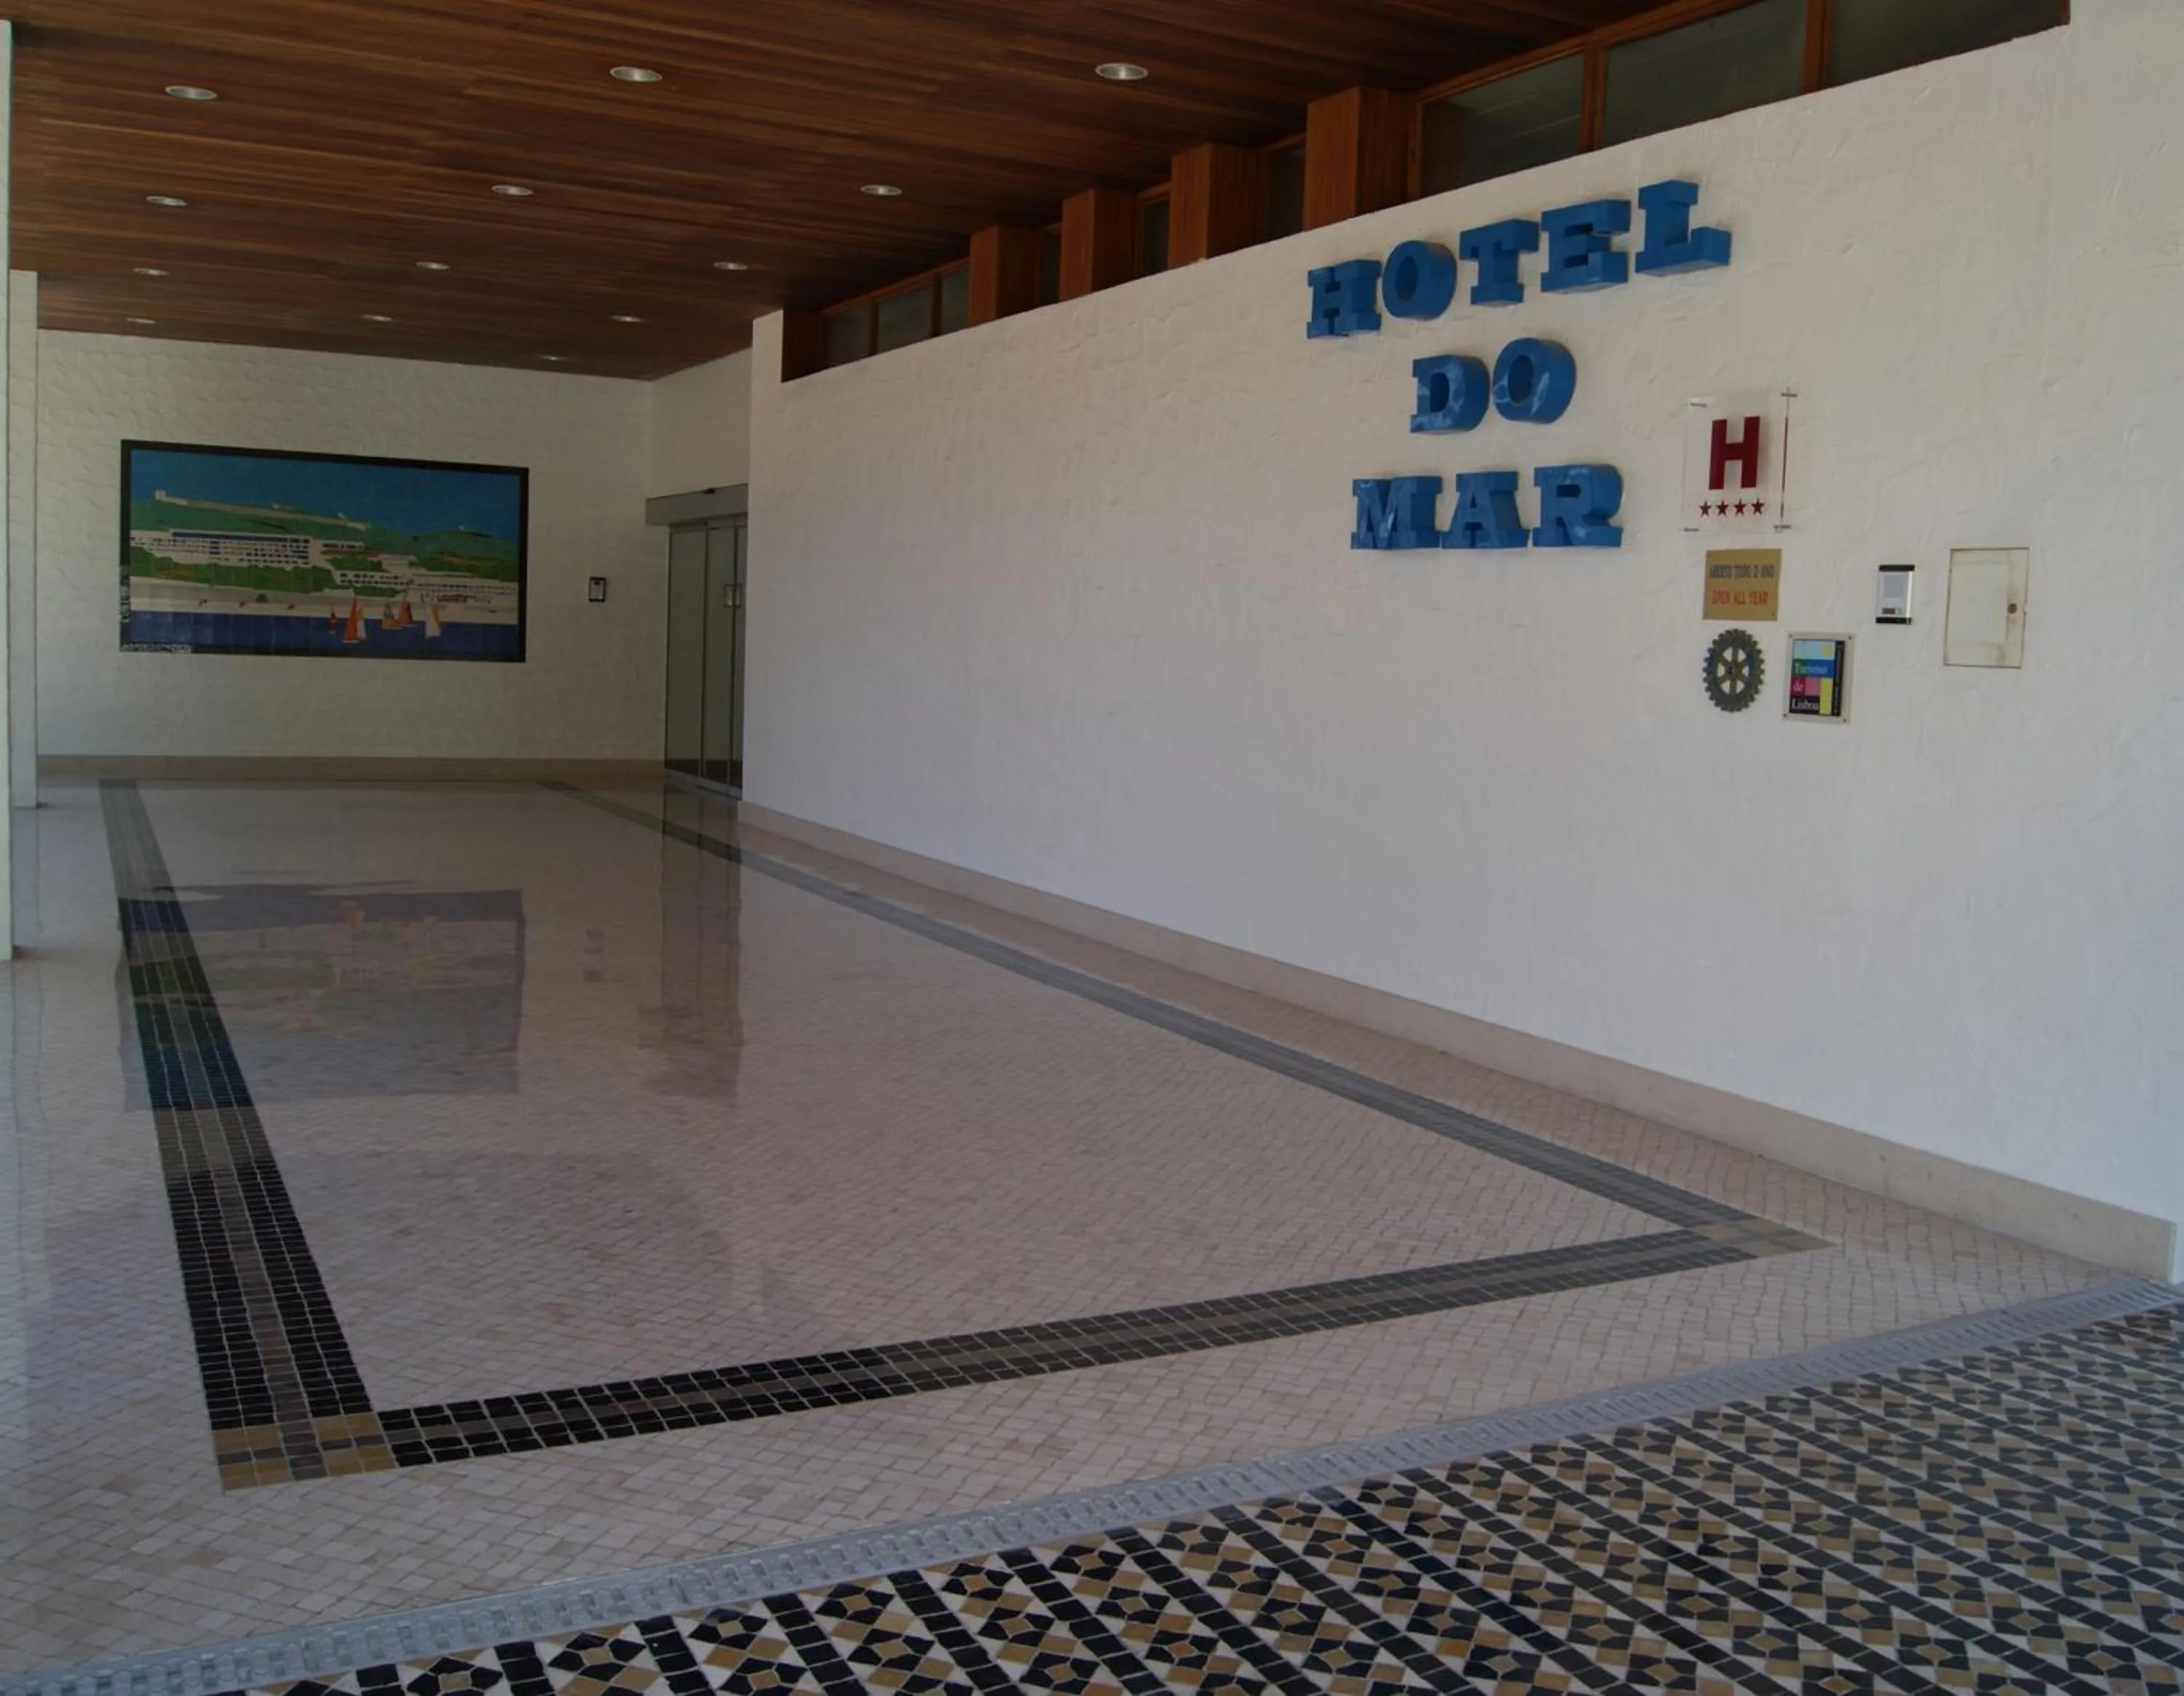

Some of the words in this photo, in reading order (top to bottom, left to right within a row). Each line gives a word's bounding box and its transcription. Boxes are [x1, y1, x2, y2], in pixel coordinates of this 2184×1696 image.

[1307, 180, 1731, 339] HOTEL
[1409, 337, 1578, 432] DO
[1709, 416, 1760, 490] H
[1350, 464, 1624, 550] MAR
[1712, 589, 1730, 606] OPEN
[1733, 589, 1746, 606] ALL
[1748, 589, 1769, 606] YEAR
